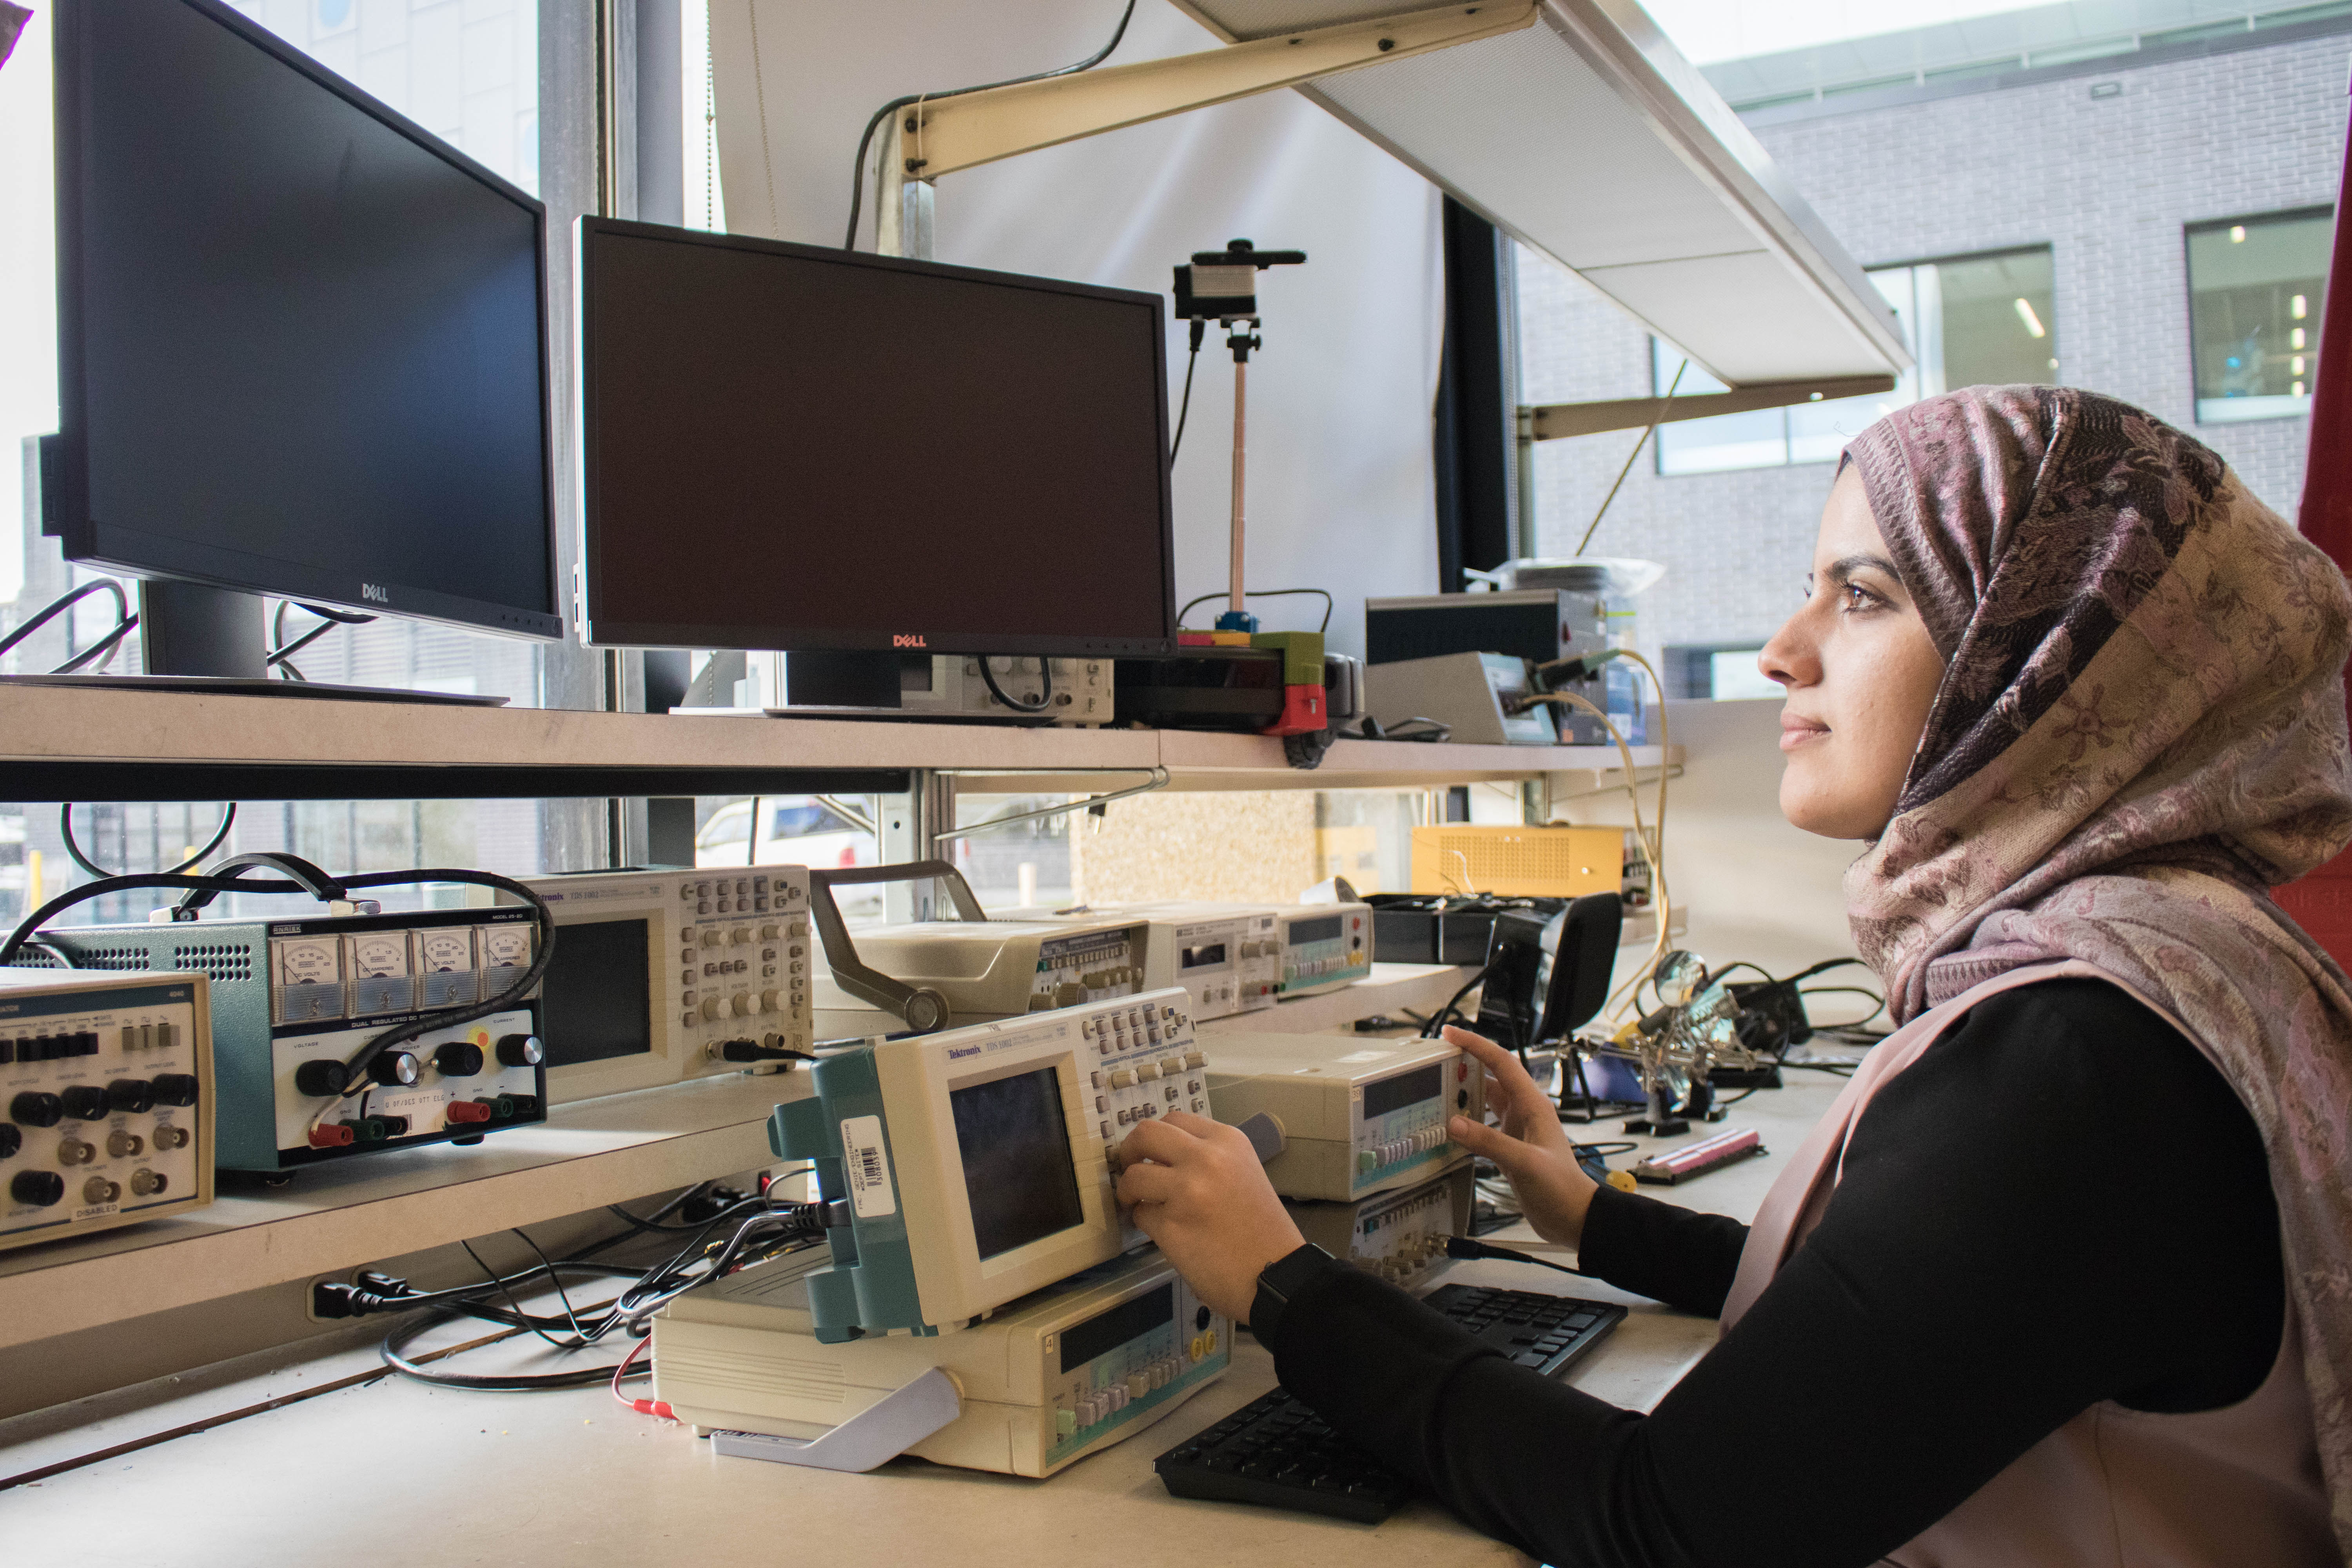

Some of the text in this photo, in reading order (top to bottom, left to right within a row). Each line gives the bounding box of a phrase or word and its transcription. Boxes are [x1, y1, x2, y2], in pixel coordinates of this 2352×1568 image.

[363, 583, 388, 603] DELL
[893, 635, 926, 648] DELL
[274, 925, 301, 934] ANATEK
[948, 1045, 982, 1059] Tektronix
[986, 1038, 1013, 1052] TDS 1002
[845, 1123, 860, 1190] GENIE/ENGINEERING
[873, 1151, 883, 1181] 308039
[77, 1205, 117, 1217] DISABLED
[1046, 1339, 1052, 1349] 4
